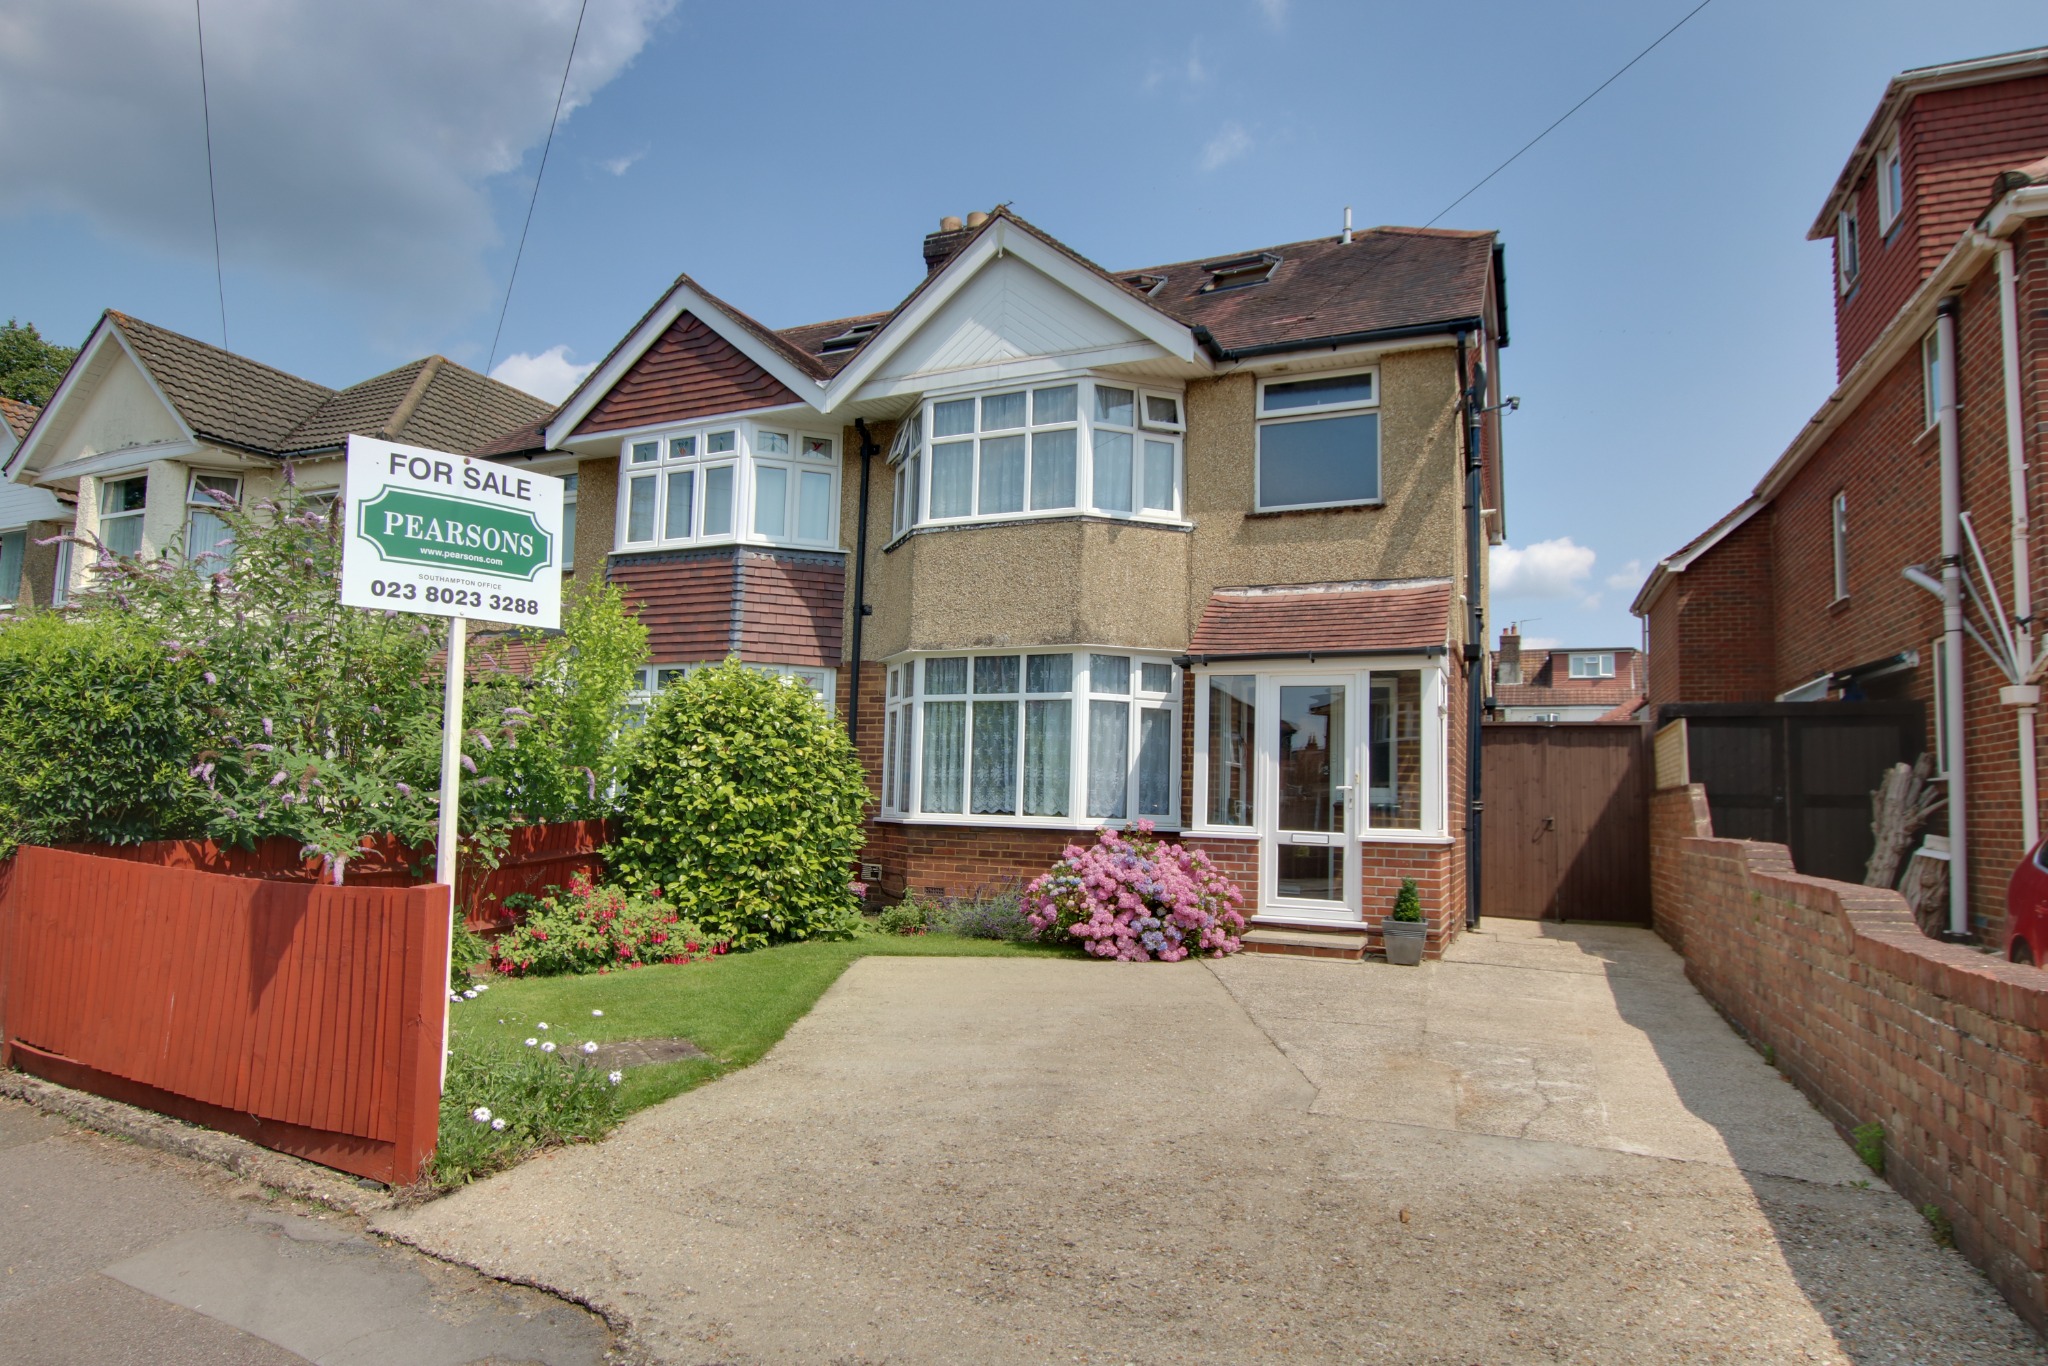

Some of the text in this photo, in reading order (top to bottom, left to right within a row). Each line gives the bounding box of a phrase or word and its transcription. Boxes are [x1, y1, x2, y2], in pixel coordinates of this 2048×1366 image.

[389, 452, 532, 501] FOR SALE
[383, 510, 534, 557] PEARSONS
[420, 547, 503, 566] www.pearsons.com
[370, 579, 539, 615] 023 8023 3288
[418, 573, 502, 590] SOUTHAMPTON OFFICE
